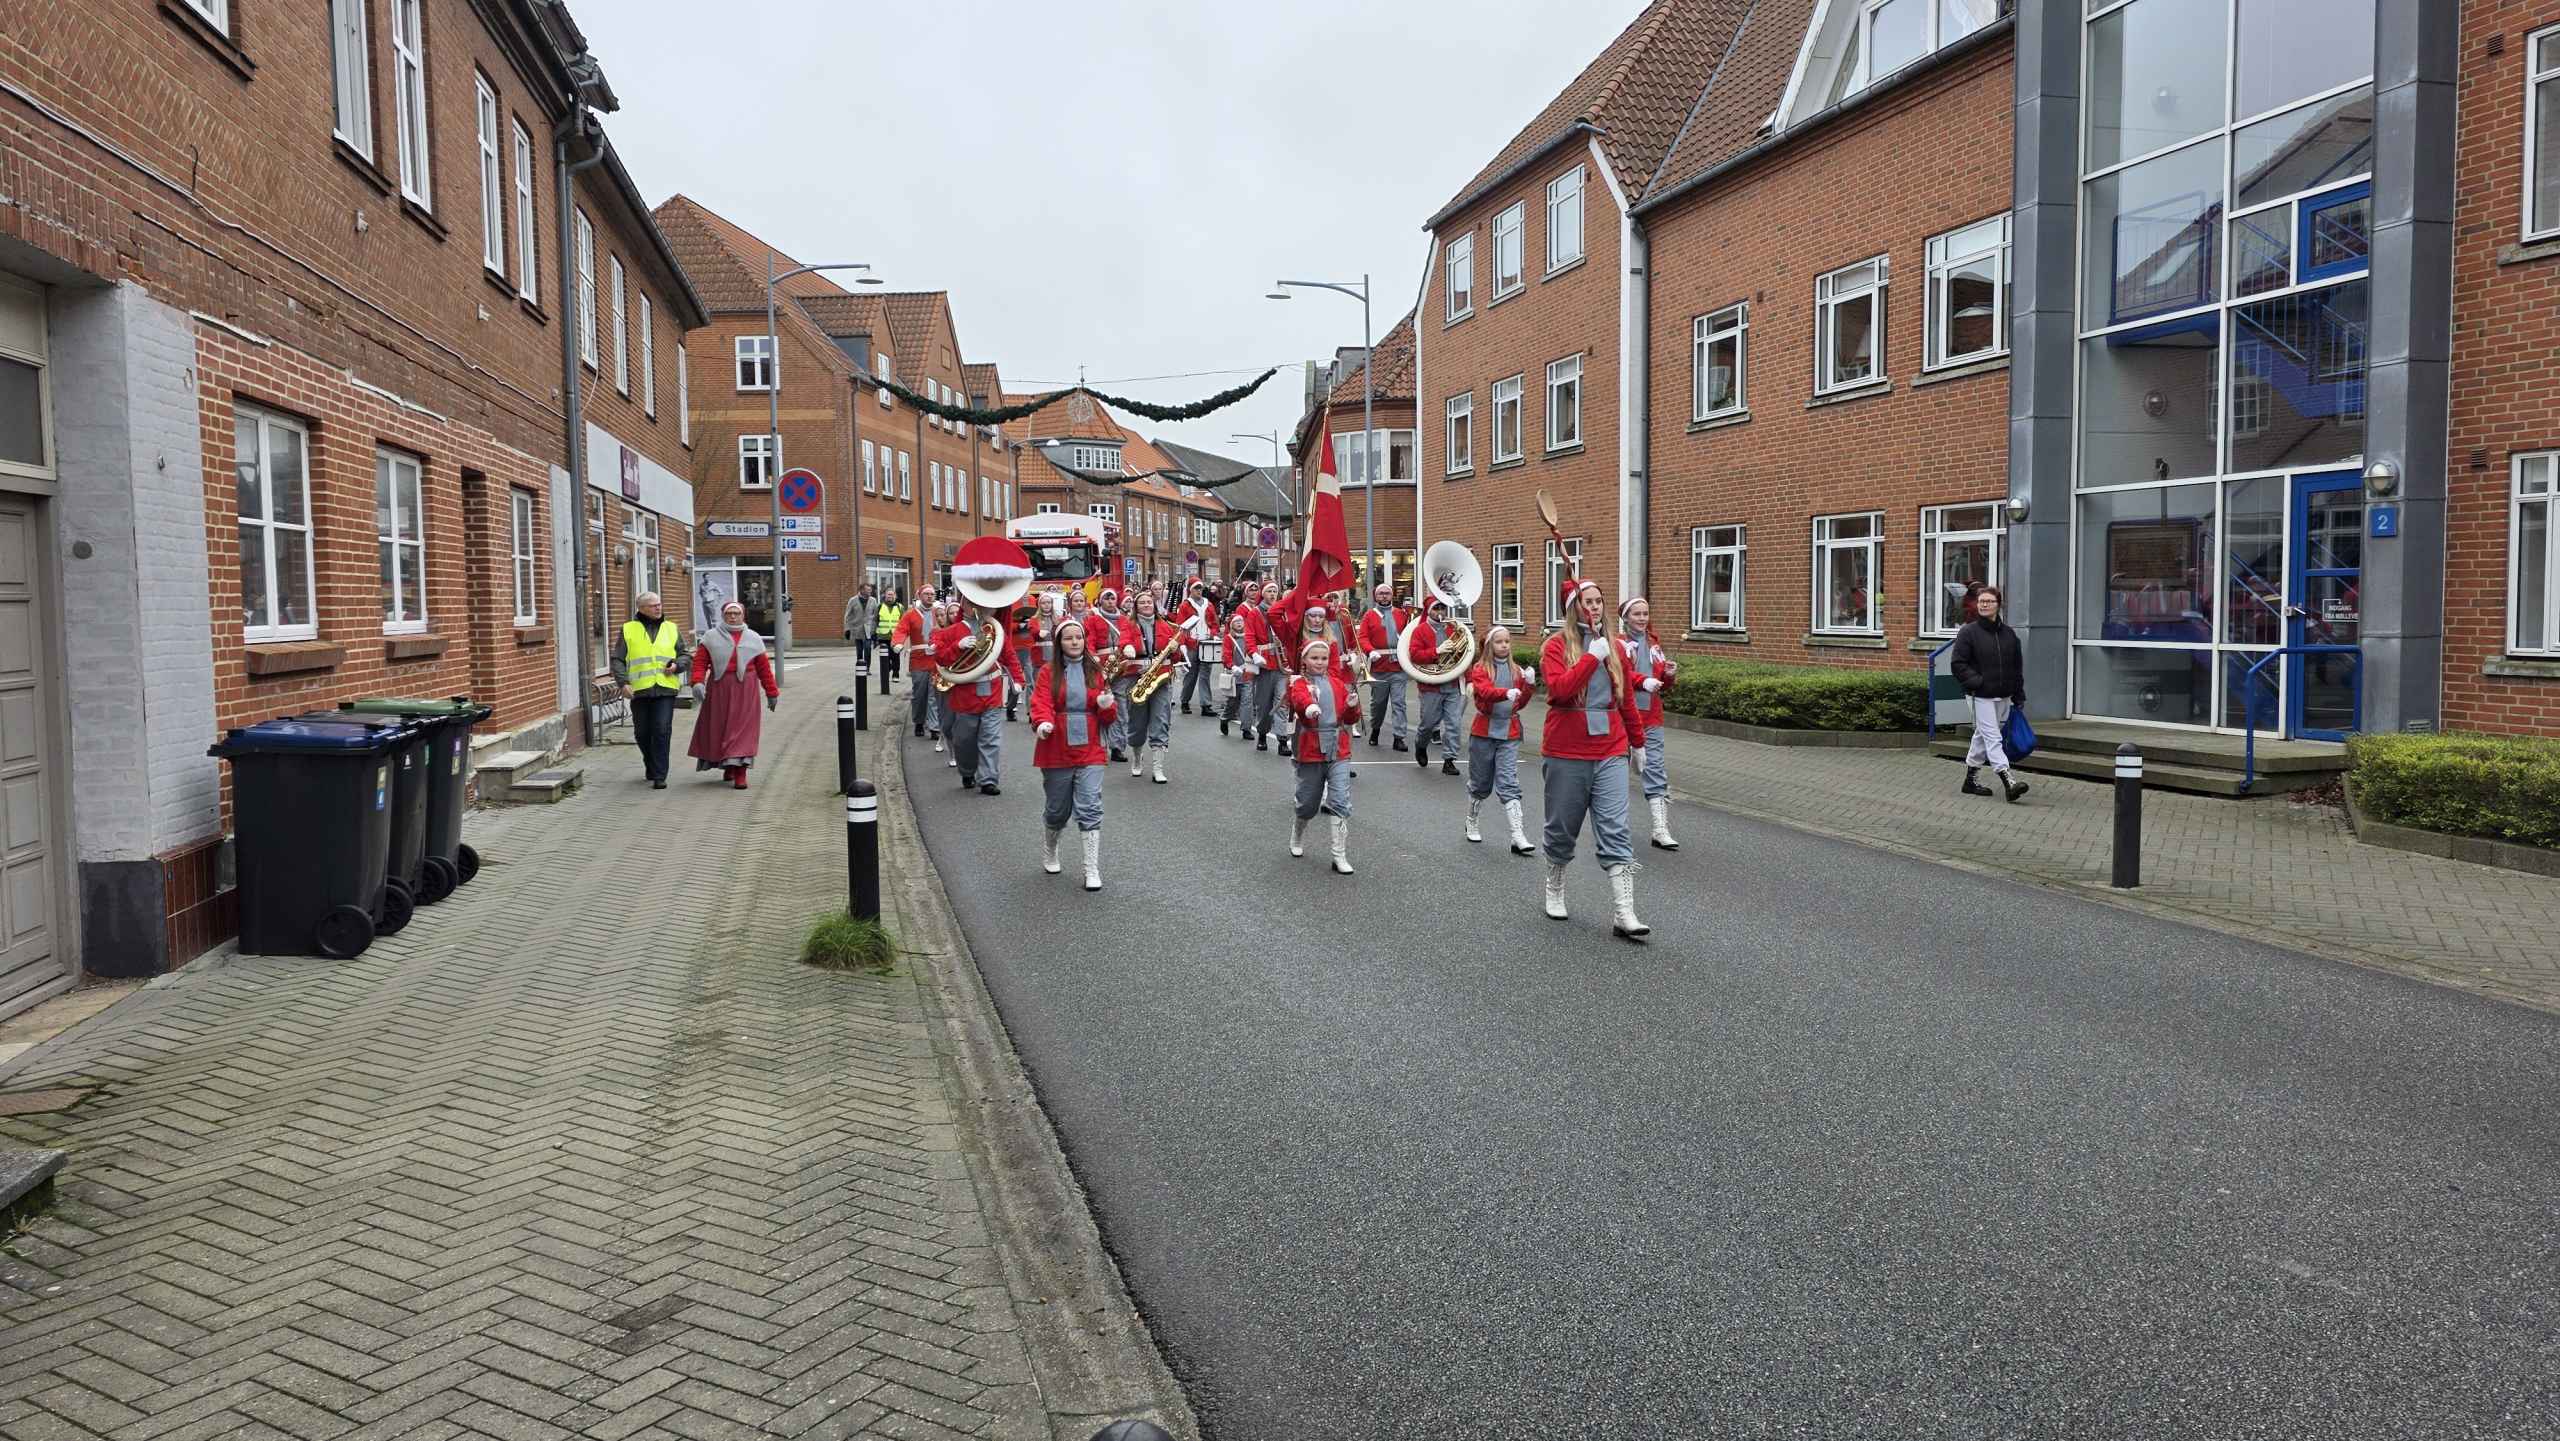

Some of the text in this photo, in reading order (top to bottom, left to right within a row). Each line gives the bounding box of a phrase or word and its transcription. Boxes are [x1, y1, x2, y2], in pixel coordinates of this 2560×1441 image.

[788, 520, 795, 528] P
[2378, 514, 2388, 530] 2
[725, 525, 765, 533] Stadion
[788, 540, 795, 548] P
